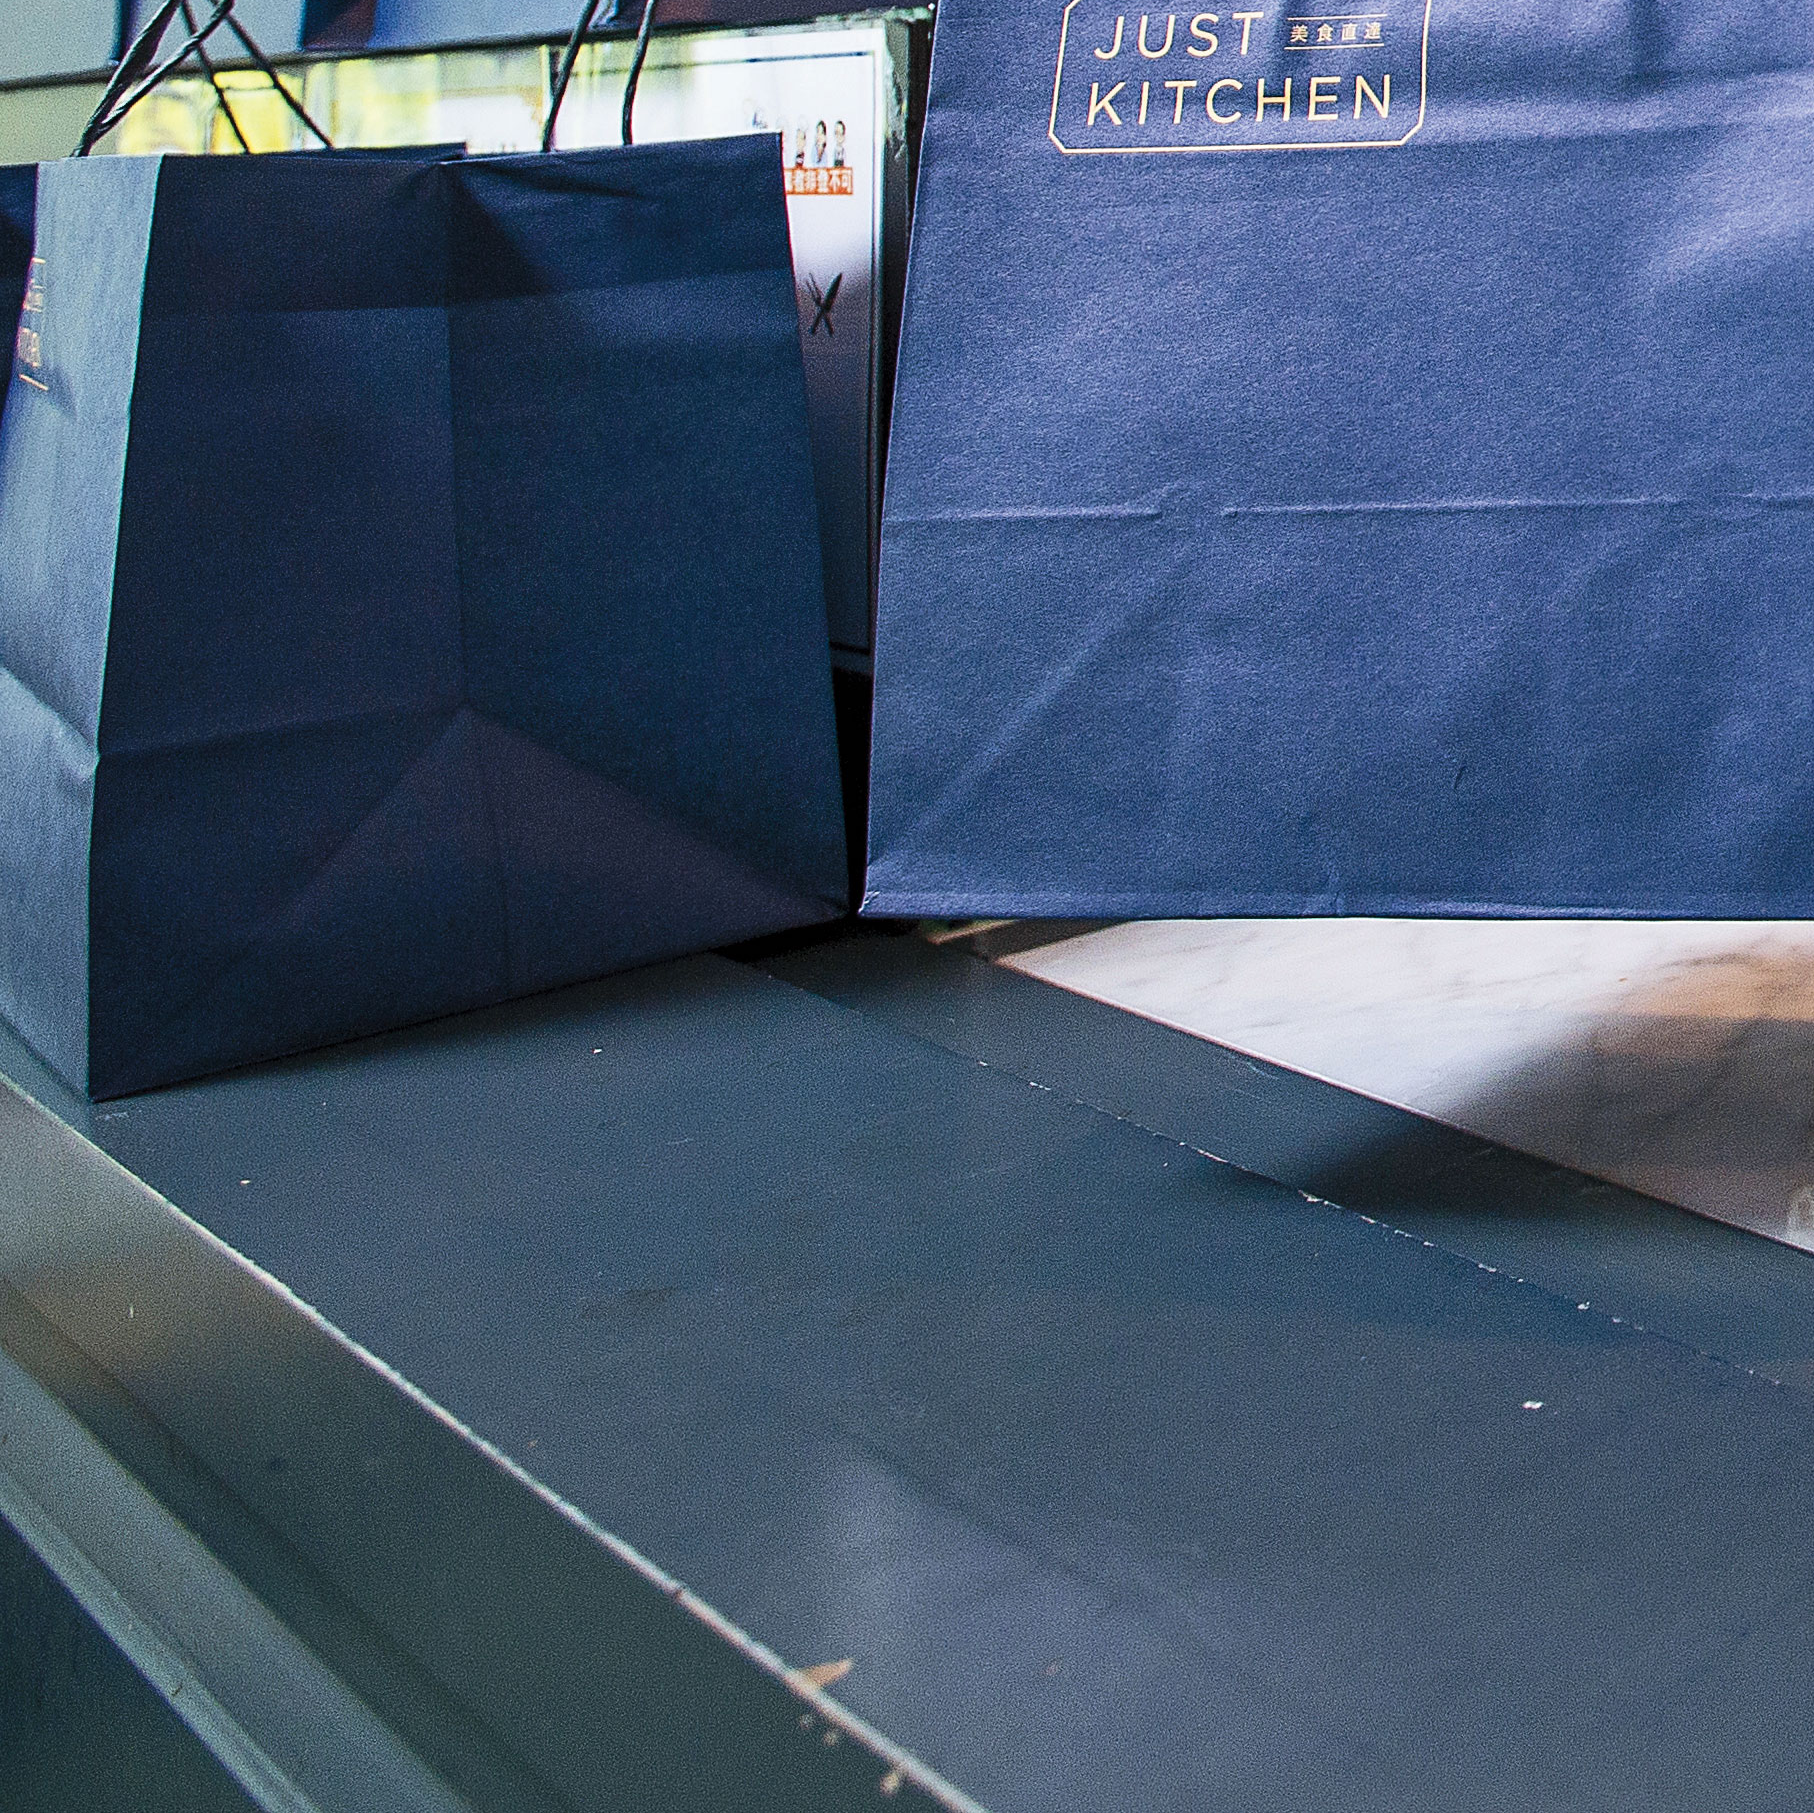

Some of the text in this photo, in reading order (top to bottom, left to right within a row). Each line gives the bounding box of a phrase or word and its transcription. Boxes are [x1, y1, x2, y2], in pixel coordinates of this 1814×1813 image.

[1093, 11, 1265, 60] JUST
[1290, 22, 1383, 44] 美食直達
[1086, 74, 1392, 127] KITCHEN
